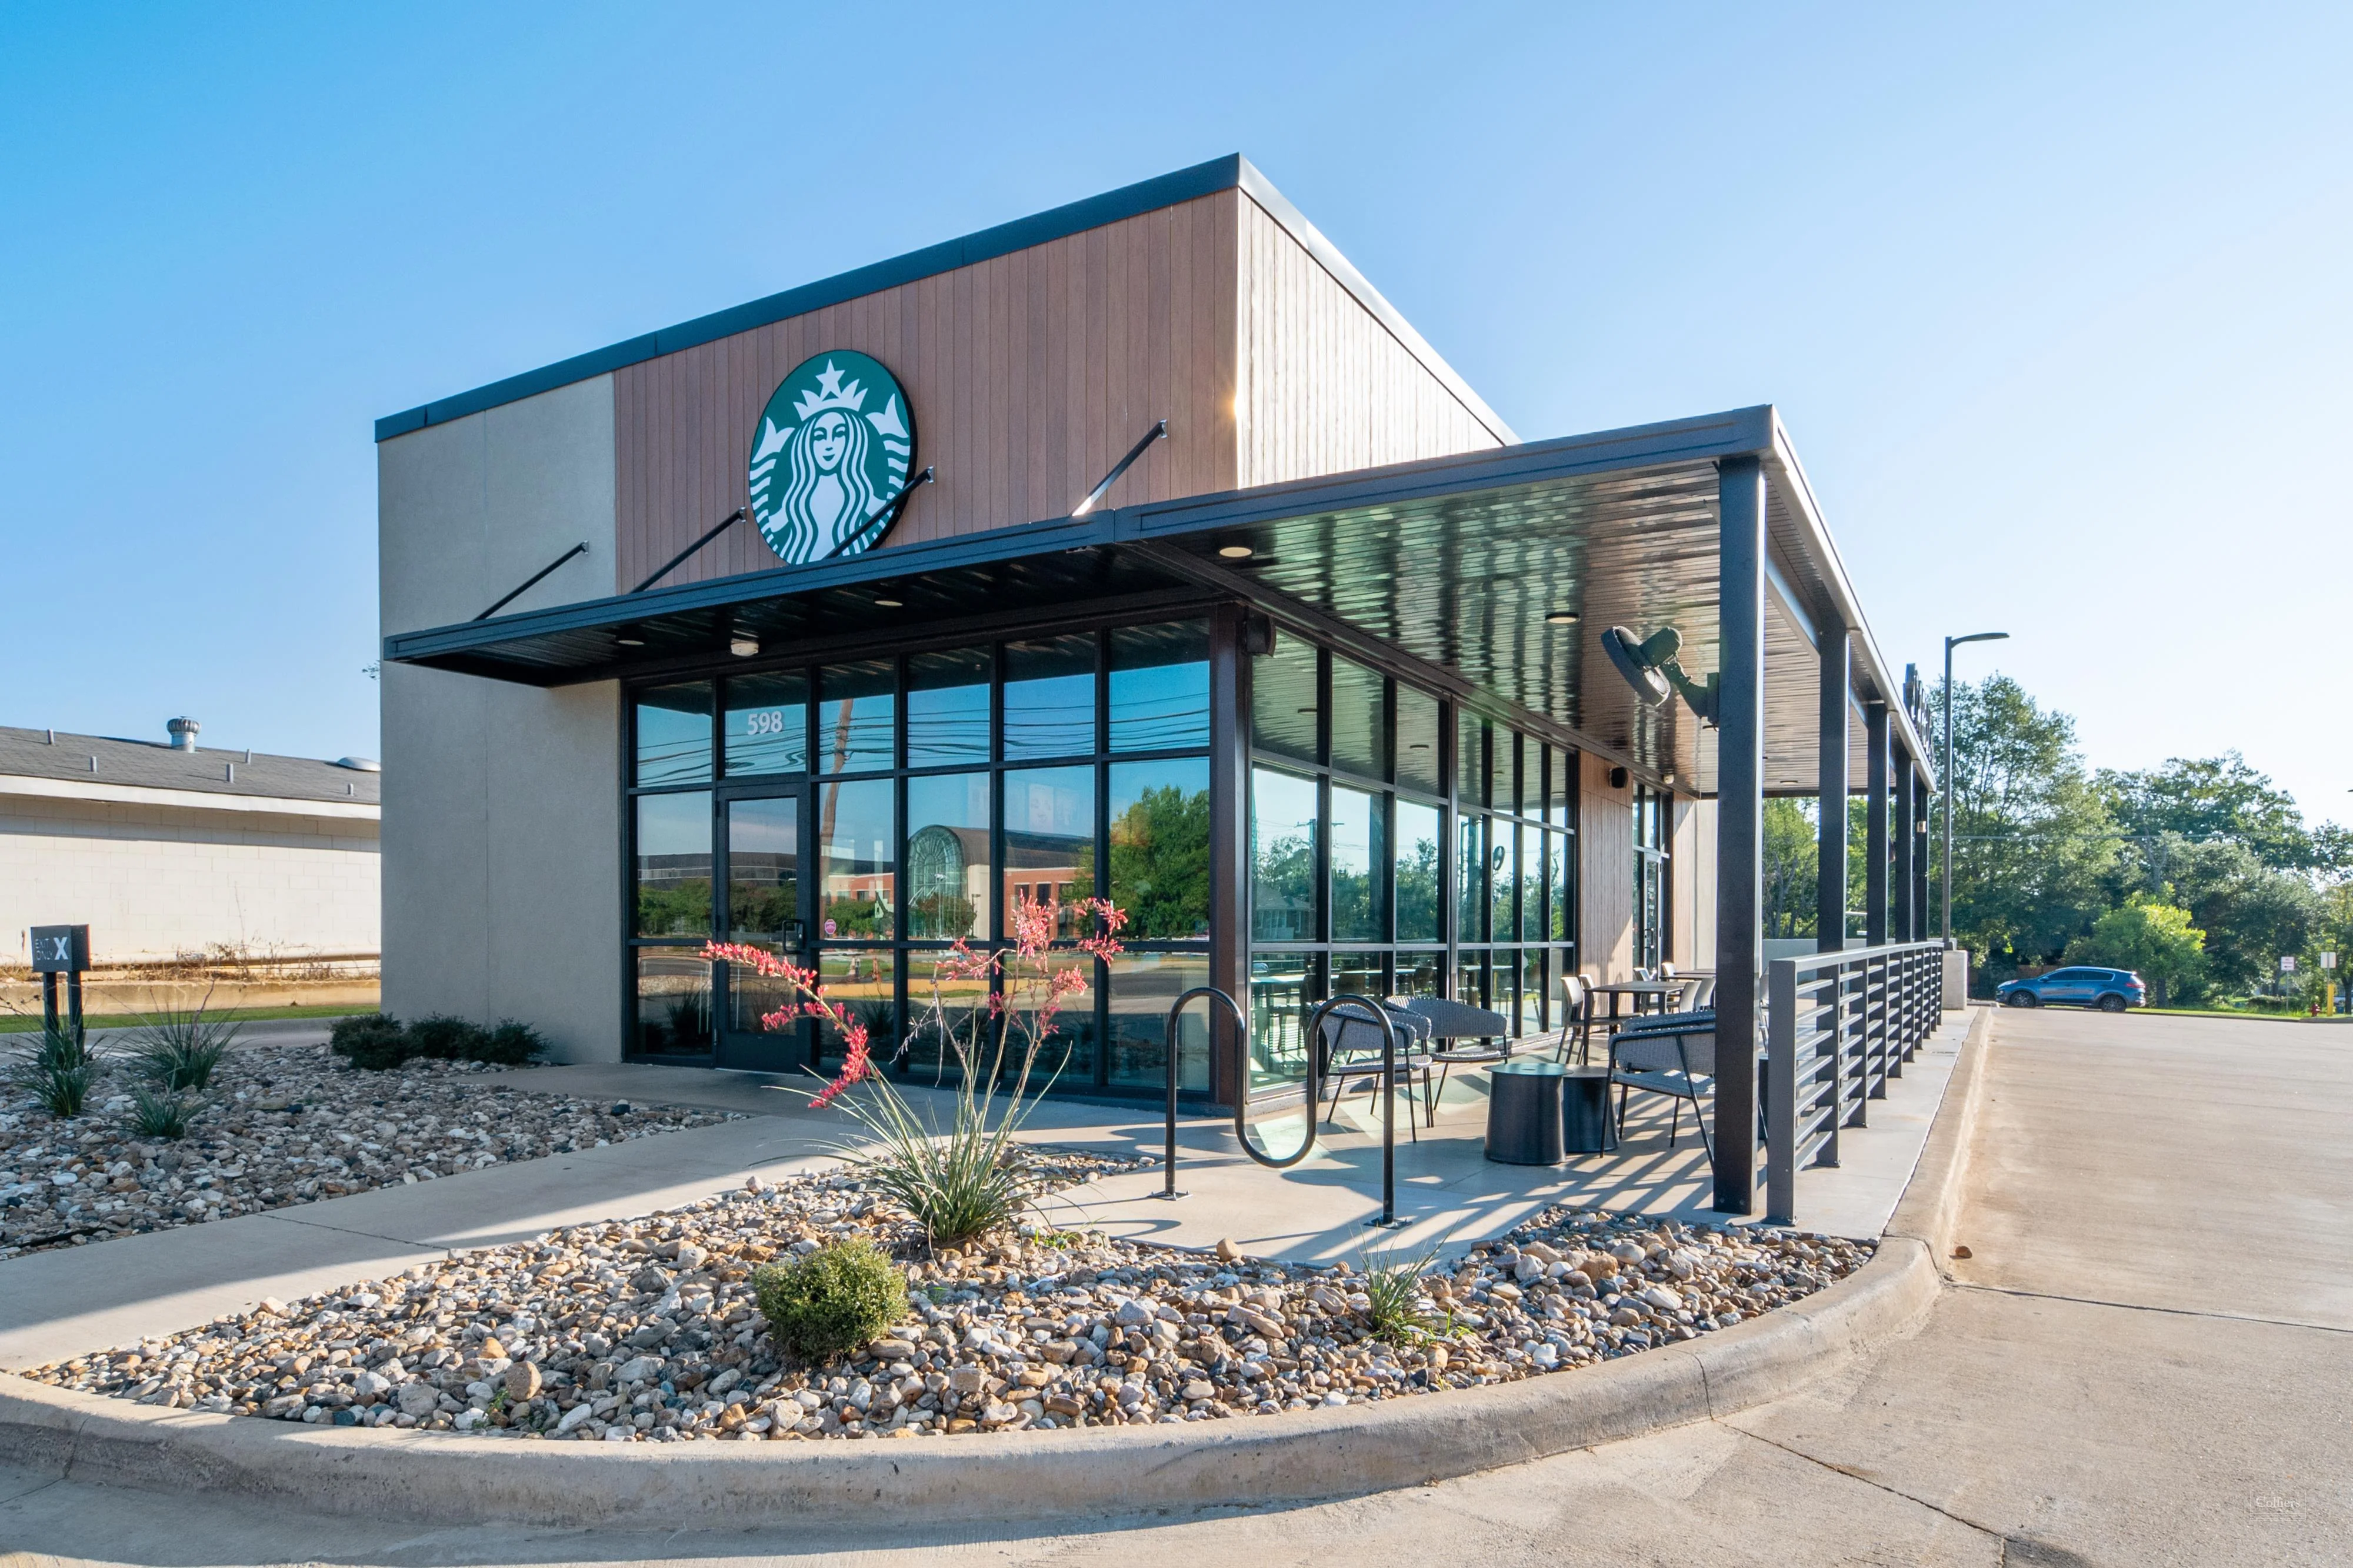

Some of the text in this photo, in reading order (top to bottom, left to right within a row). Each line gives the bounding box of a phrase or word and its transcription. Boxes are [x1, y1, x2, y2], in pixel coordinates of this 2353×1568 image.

[748, 710, 782, 735] 598
[35, 938, 49, 949] EXIT
[36, 950, 52, 960] ONLY
